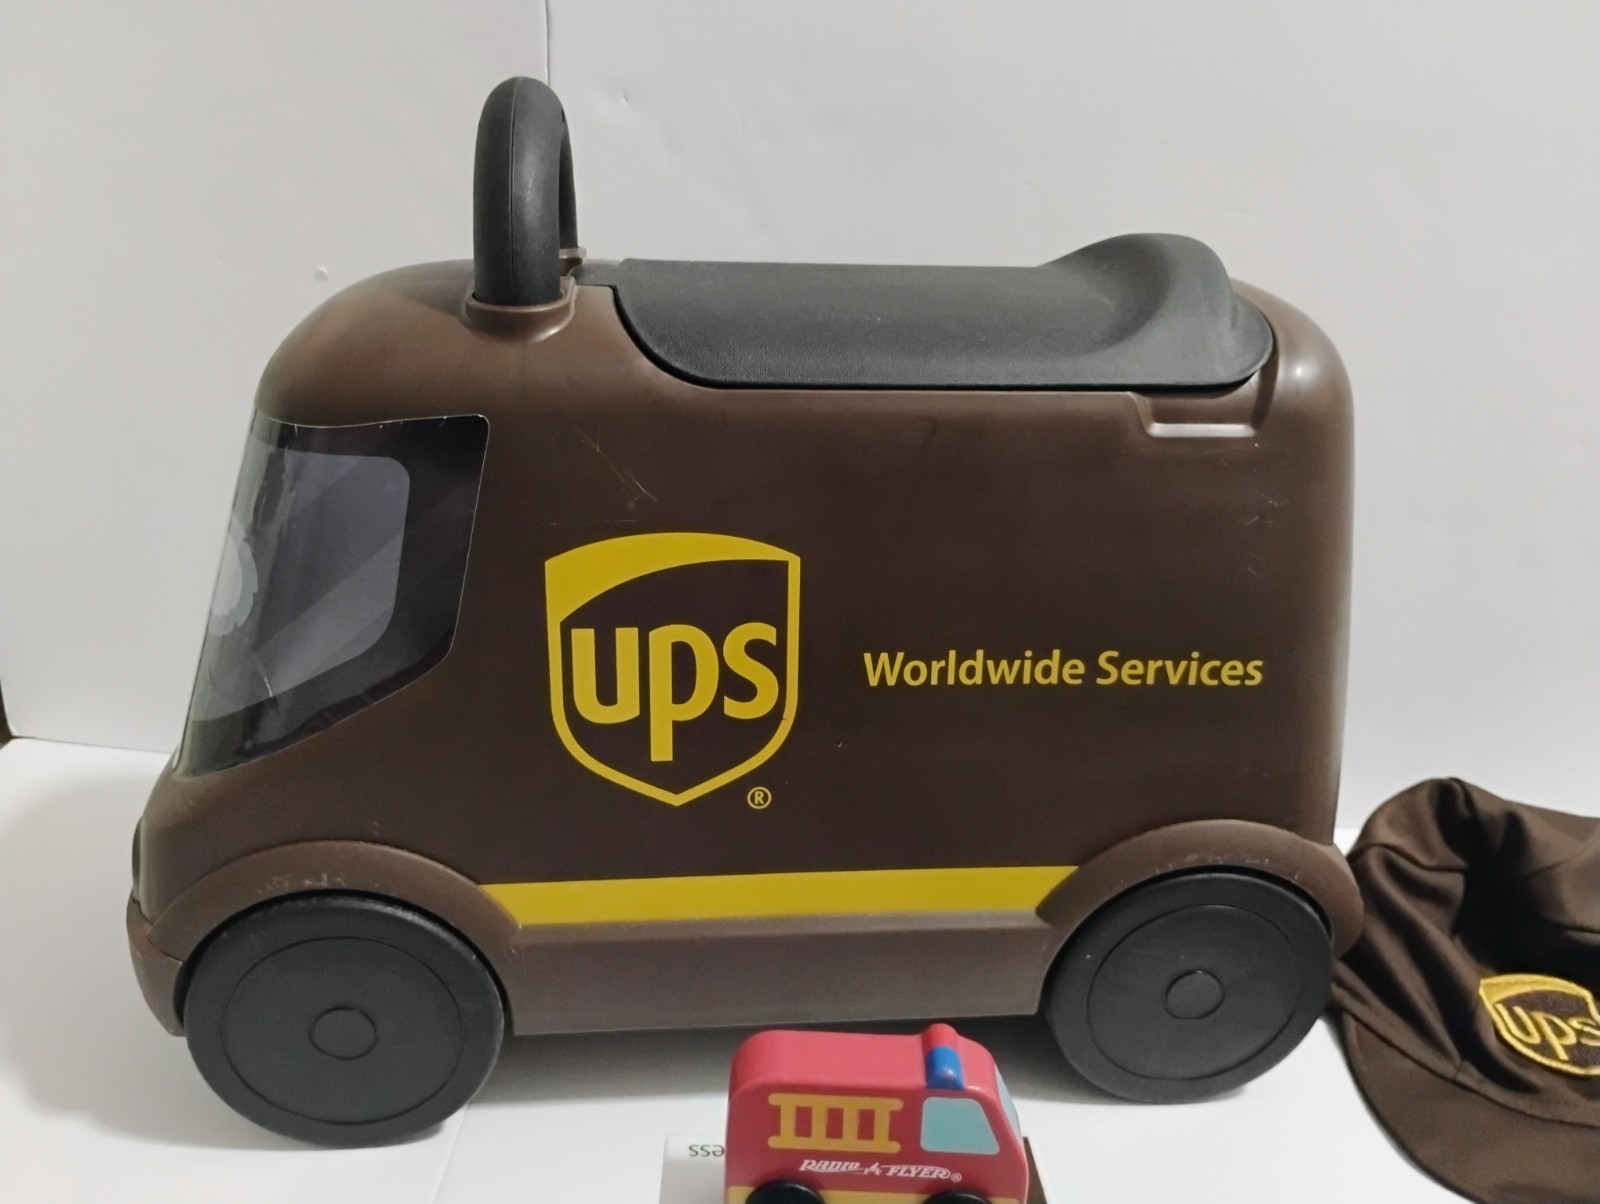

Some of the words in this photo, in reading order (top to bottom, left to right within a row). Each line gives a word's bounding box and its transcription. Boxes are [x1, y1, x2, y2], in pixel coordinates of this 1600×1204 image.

[863, 649, 1086, 687] Worldwide
[1095, 650, 1264, 687] Services
[571, 622, 779, 762] ups
[799, 1159, 864, 1173] RADIO
